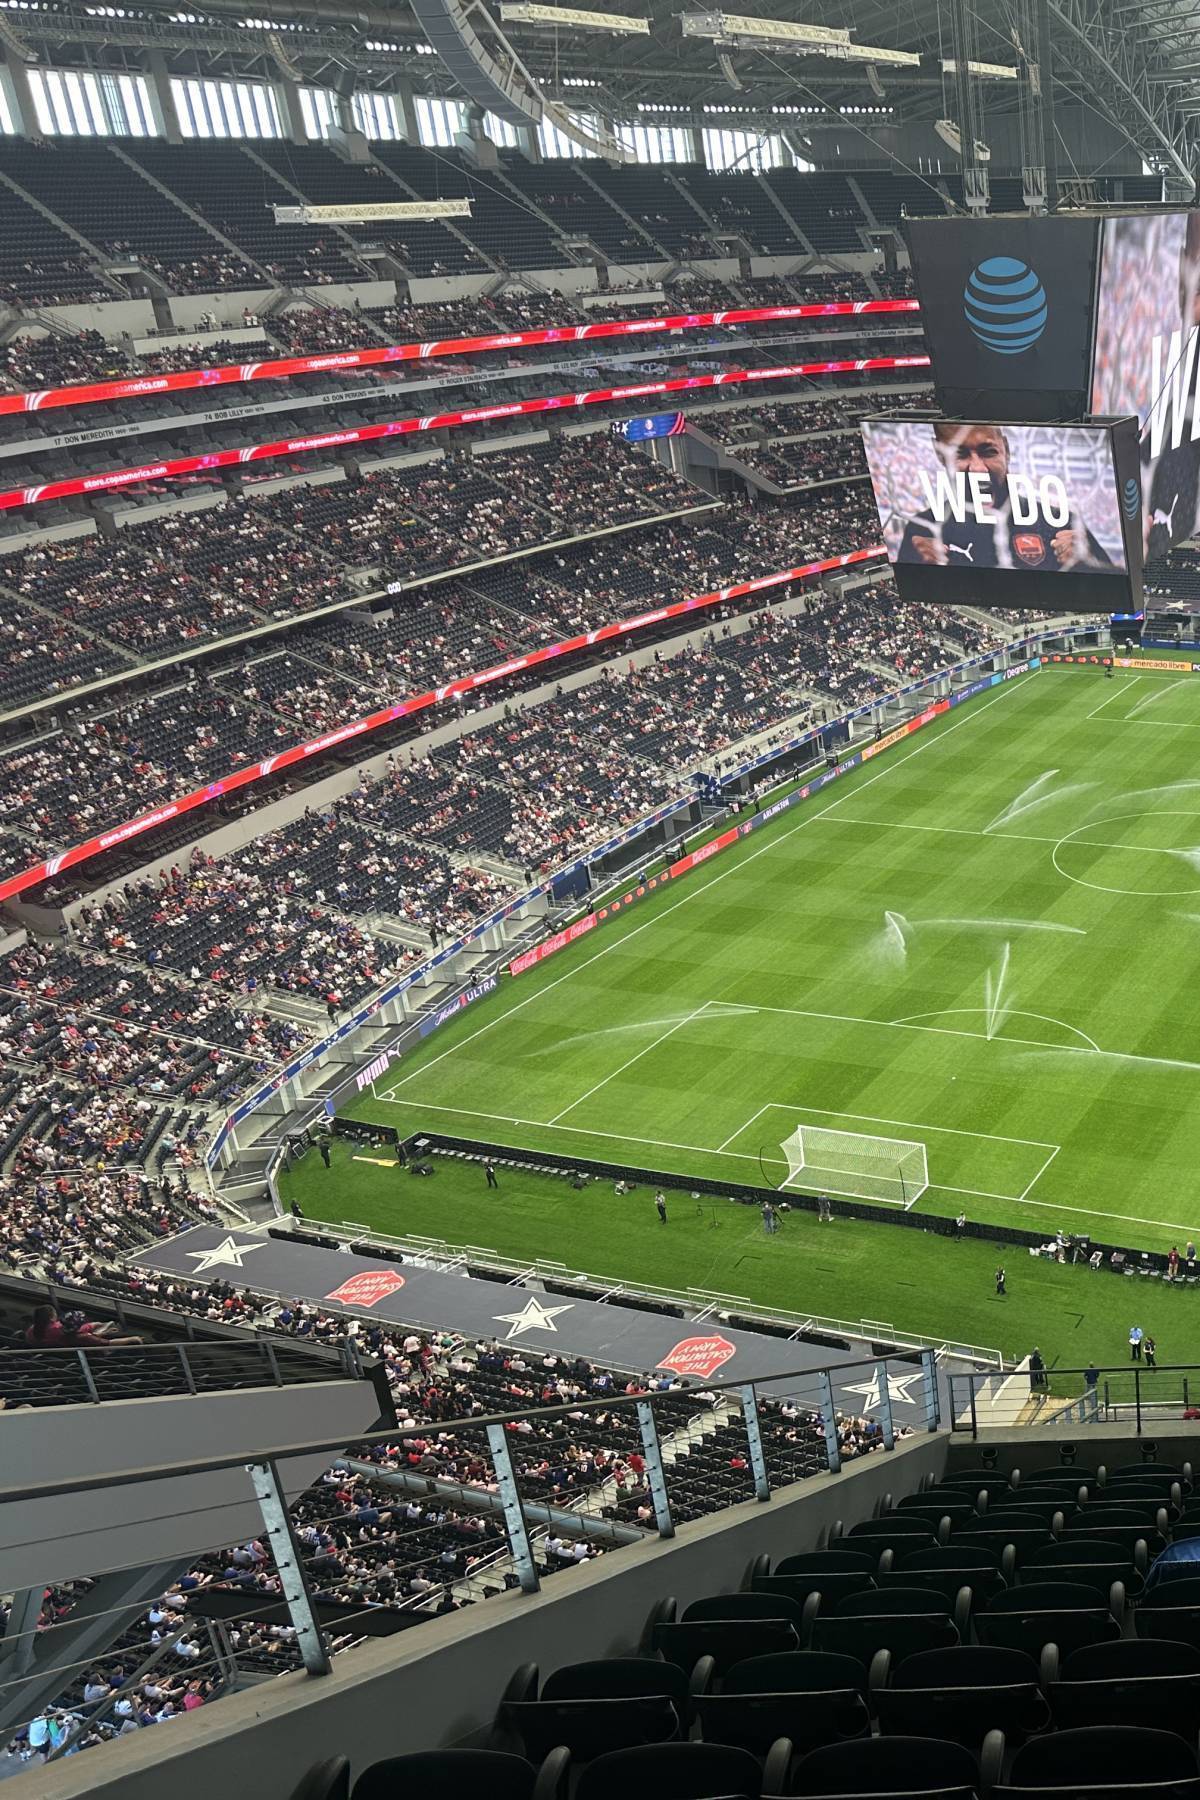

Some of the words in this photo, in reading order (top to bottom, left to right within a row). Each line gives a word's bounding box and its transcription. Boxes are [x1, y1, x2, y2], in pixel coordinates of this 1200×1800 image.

[214, 411, 228, 419] BOB
[228, 409, 243, 418] LILLY
[54, 438, 61, 446] 17
[64, 435, 80, 444] DON
[80, 430, 114, 440] MEREDITH
[287, 432, 360, 450] store.copaamerica.com
[83, 467, 168, 489] store.copaamerica.com
[919, 470, 997, 525] WE
[1005, 474, 1070, 528] DO
[1007, 664, 1029, 679] Degree
[762, 798, 790, 820] ARLINGTON
[99, 805, 178, 847] store.copaamerica.com
[466, 978, 497, 1001] ULTRA
[677, 1341, 721, 1354] ARMY
[664, 1349, 732, 1365] SALVATION
[682, 1361, 711, 1371] THE
